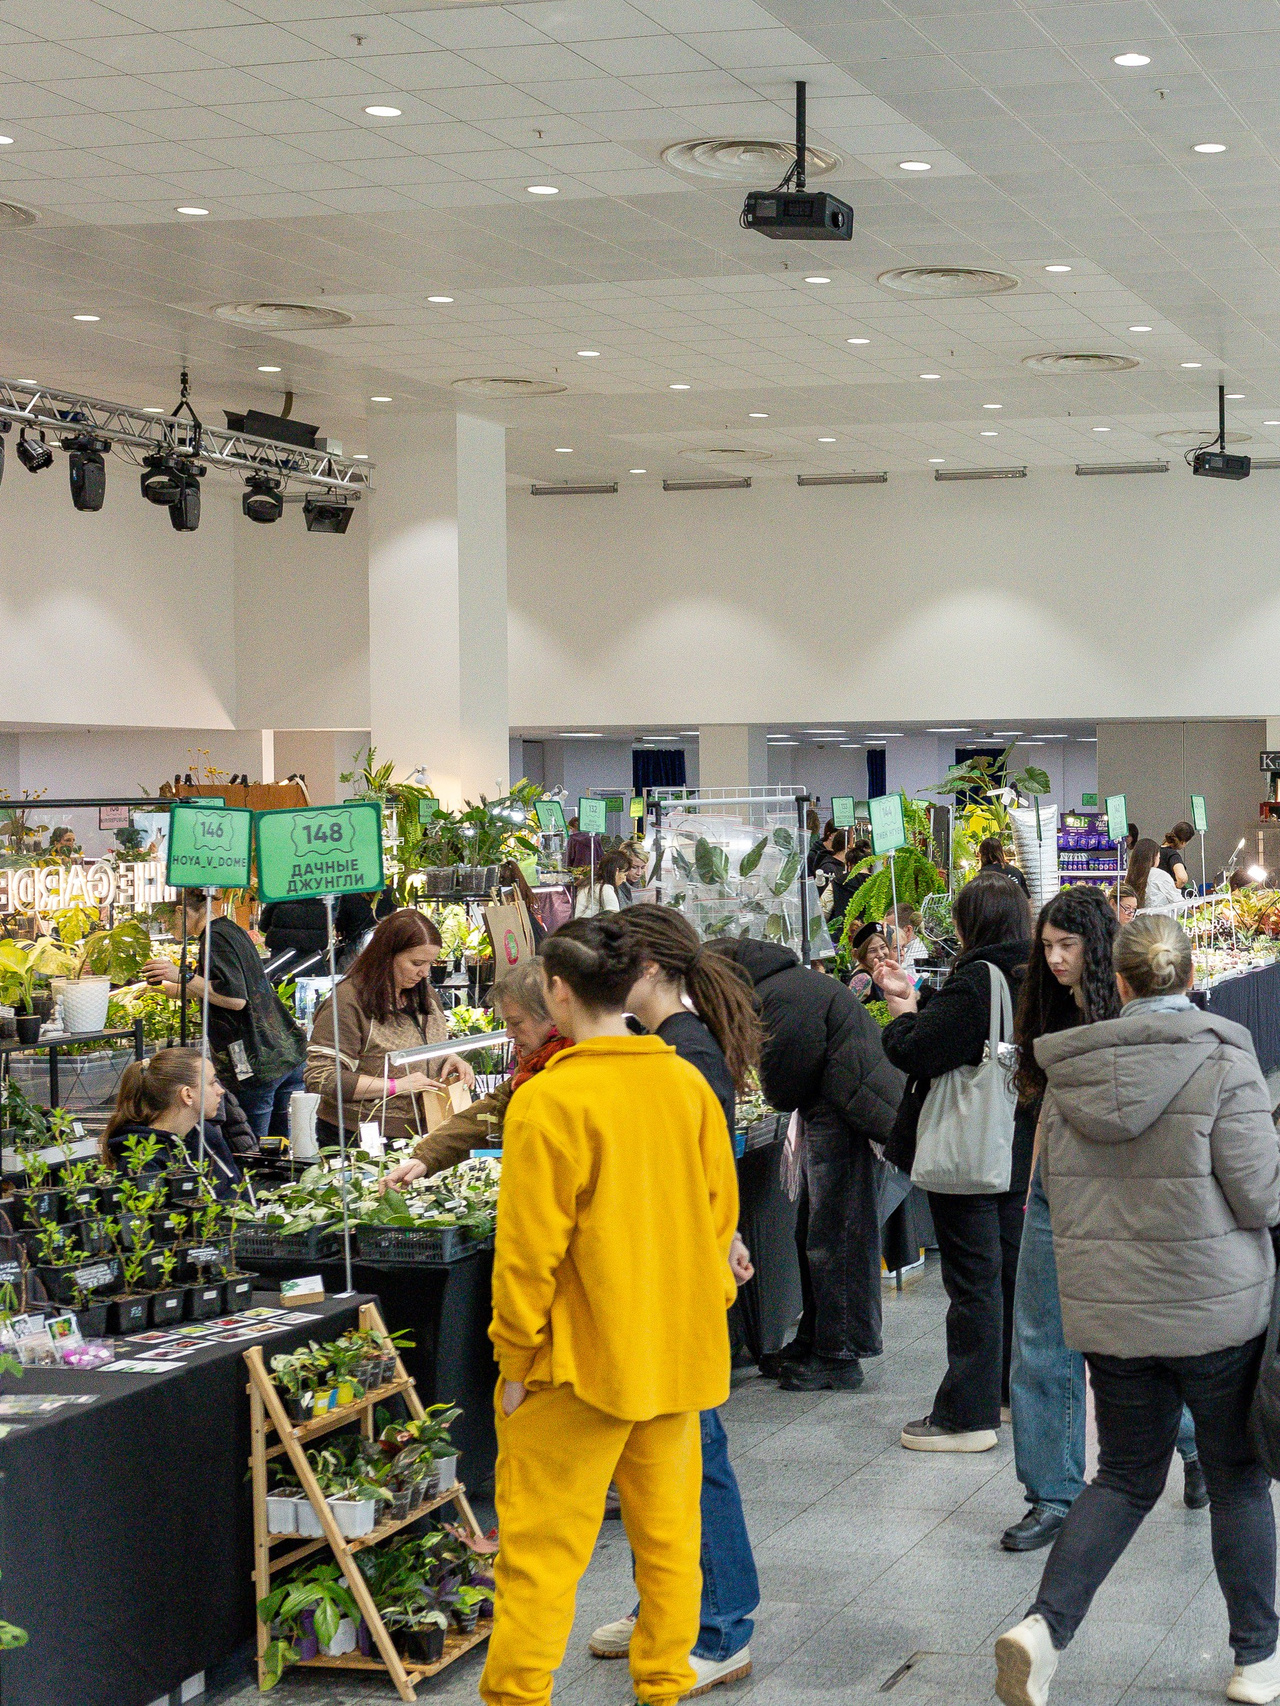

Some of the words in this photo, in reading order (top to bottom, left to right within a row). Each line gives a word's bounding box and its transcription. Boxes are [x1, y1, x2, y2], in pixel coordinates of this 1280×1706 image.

[589, 805, 598, 815] 132
[200, 821, 224, 839] 146
[302, 822, 343, 845] 148
[172, 854, 247, 869] HOYA_V_DOME
[291, 858, 359, 879] ДАЧНЫЕ
[286, 873, 365, 895] ДЖУНГЛИ
